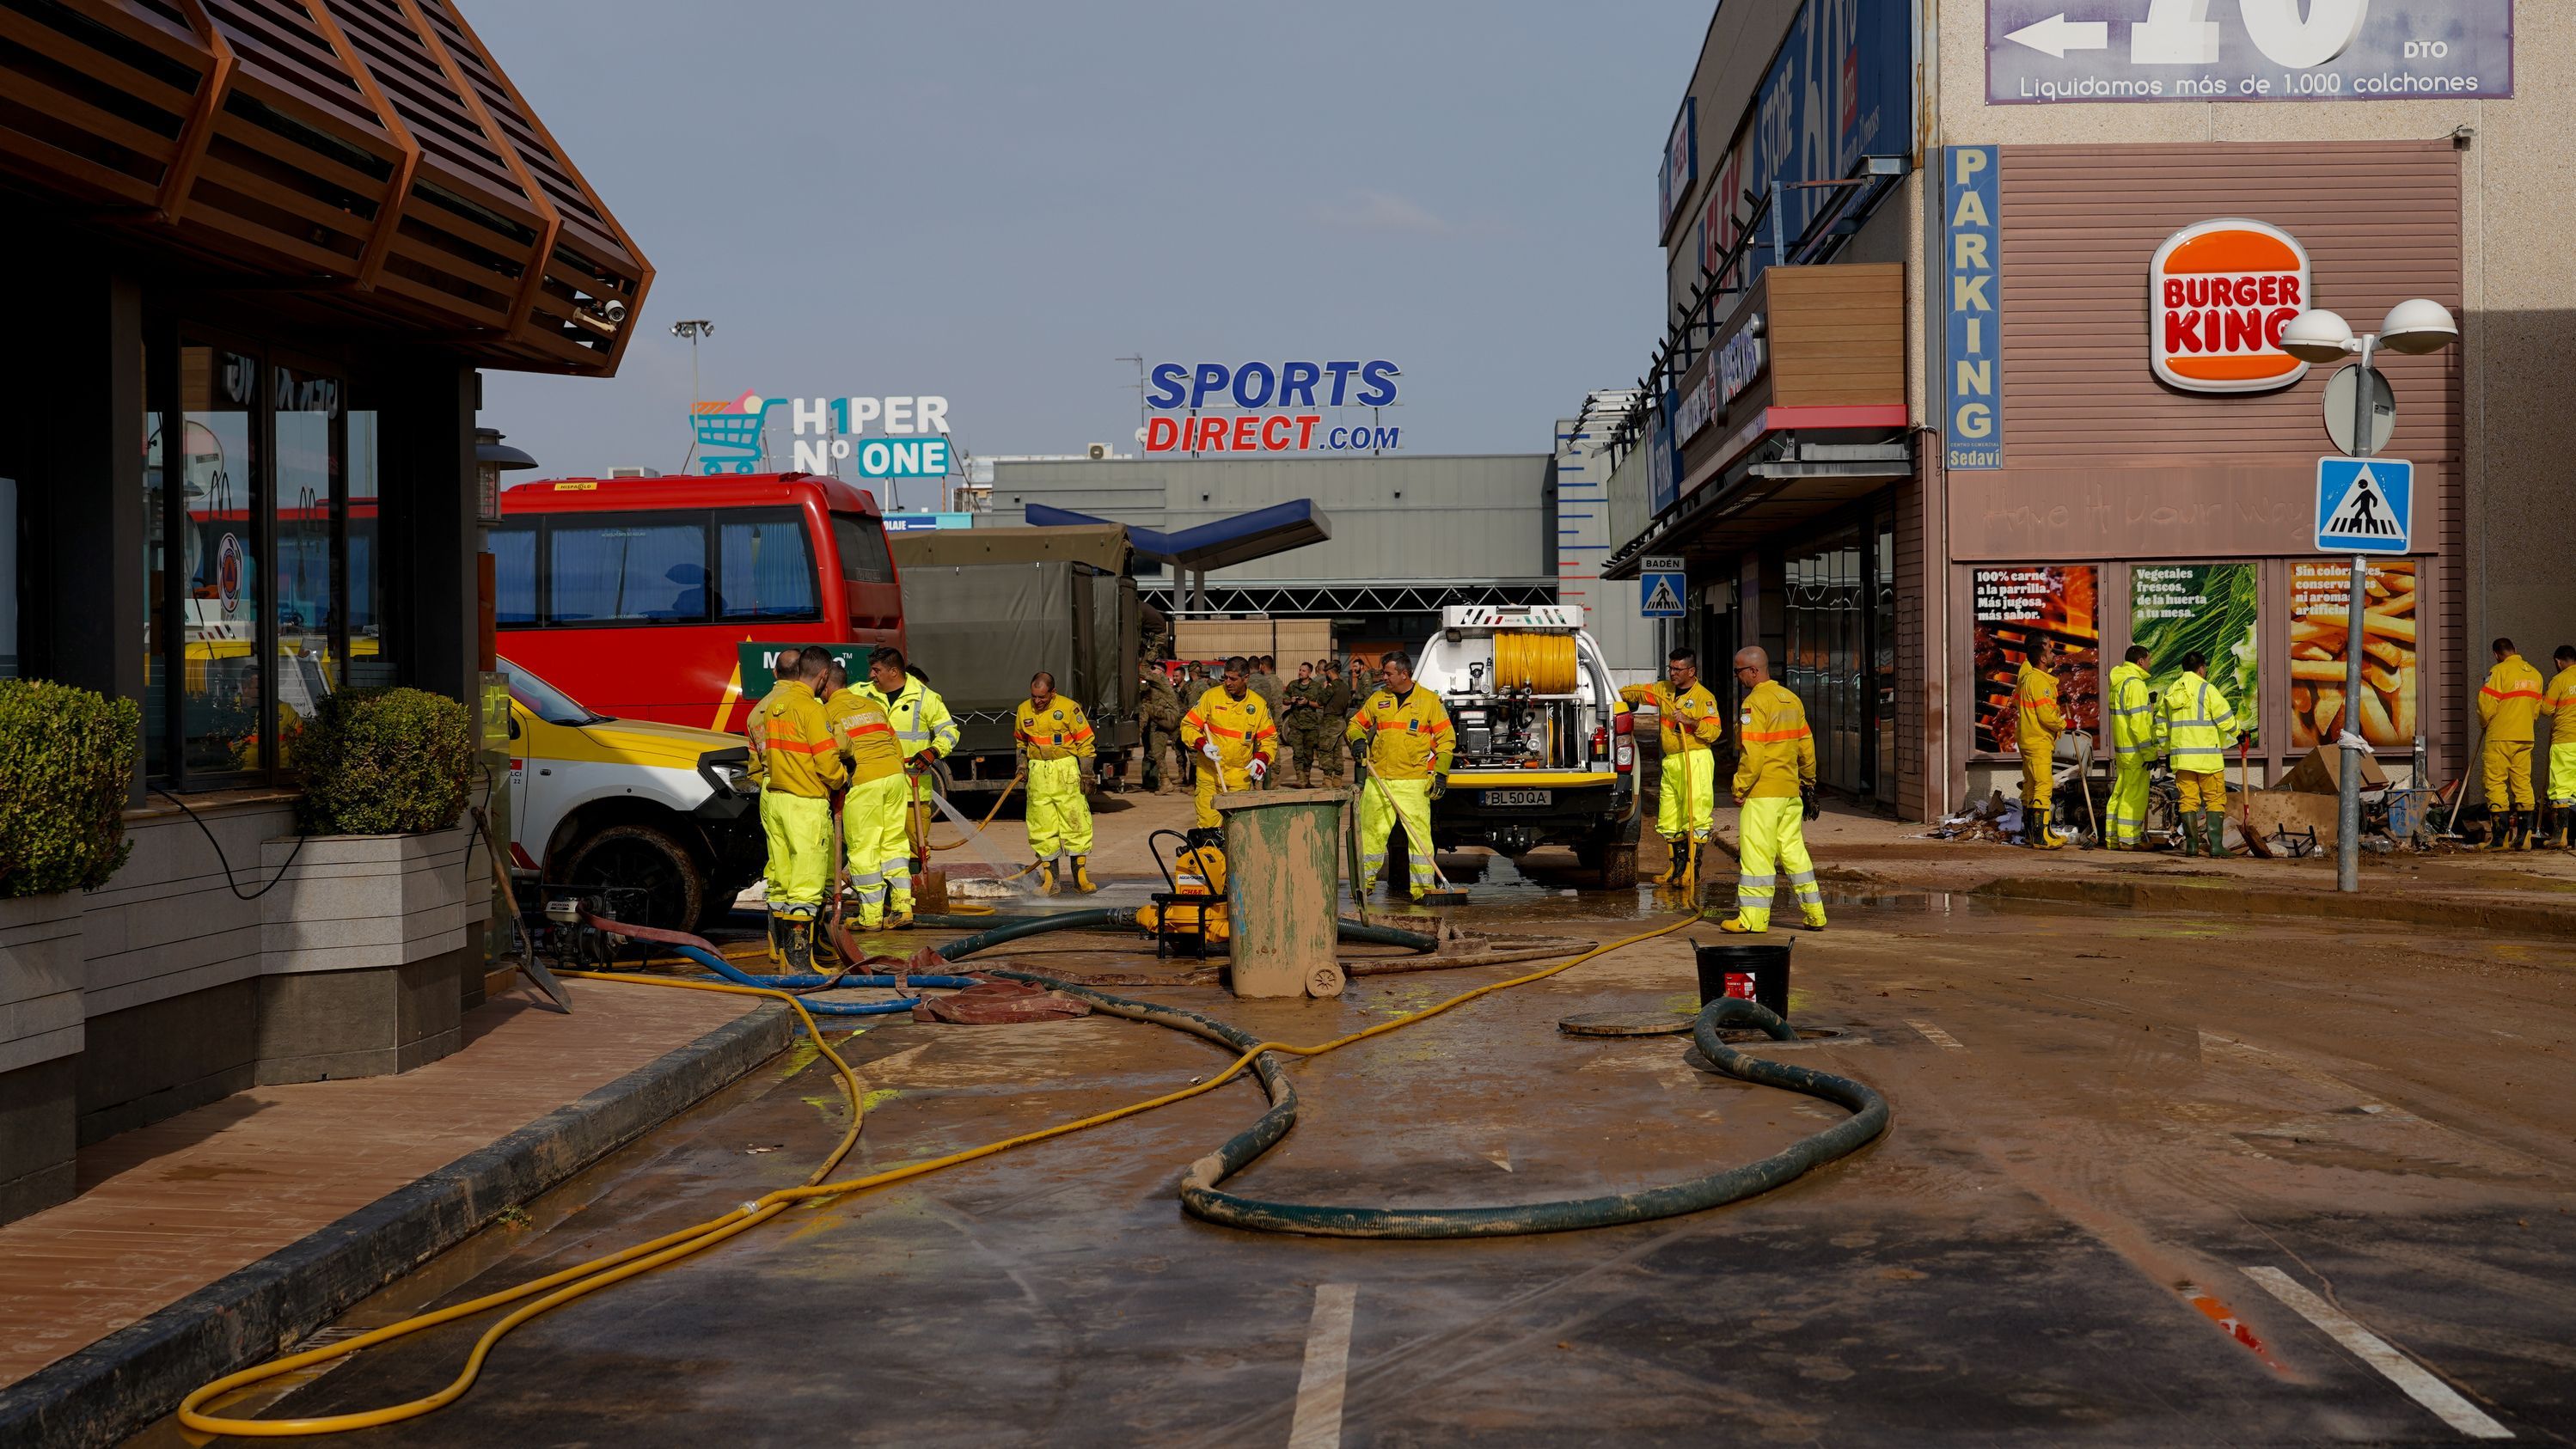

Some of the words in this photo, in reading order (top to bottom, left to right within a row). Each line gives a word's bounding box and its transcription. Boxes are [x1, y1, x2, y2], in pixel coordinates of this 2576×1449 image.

[2404, 41, 2448, 58] DTO
[2020, 76, 2163, 101] Liquidamos
[2176, 75, 2227, 95] más
[2240, 74, 2271, 95] de
[2284, 73, 2340, 94] 1.000
[2353, 72, 2478, 92] colchones
[1762, 57, 1793, 194] STORE
[1952, 149, 1992, 438] PARKING
[2163, 276, 2302, 309] BURGER
[2165, 307, 2300, 354] KING
[1145, 359, 1400, 410] SPORTS
[862, 442, 945, 474] ONE
[1950, 449, 2000, 466] Sedaví
[1646, 559, 1680, 568] BADÉN
[1977, 571, 2010, 582] 100%
[2010, 572, 2047, 582] carne
[2136, 567, 2194, 582] Vegetales
[2295, 566, 2315, 576] Sin
[2316, 566, 2385, 578] colores,
[1977, 586, 1985, 595] a
[1986, 584, 1998, 595] la
[1999, 583, 2051, 596] parrilla.
[2137, 581, 2187, 594] frescos,
[2295, 581, 2377, 590] conservaes
[1978, 596, 2002, 608] Más
[2002, 596, 2047, 610] jugosa,
[2137, 595, 2151, 605] de
[2152, 595, 2164, 605] la
[2165, 594, 2207, 605] huerta
[2295, 591, 2308, 602] ni
[1978, 609, 2002, 621] más
[2003, 609, 2041, 621] sabor.
[2137, 609, 2144, 618] a
[2145, 608, 2159, 618] tu
[2160, 608, 2196, 618] mesa.
[1491, 792, 1507, 804] BL
[1509, 792, 1525, 804] 50
[1526, 792, 1546, 804] QA
